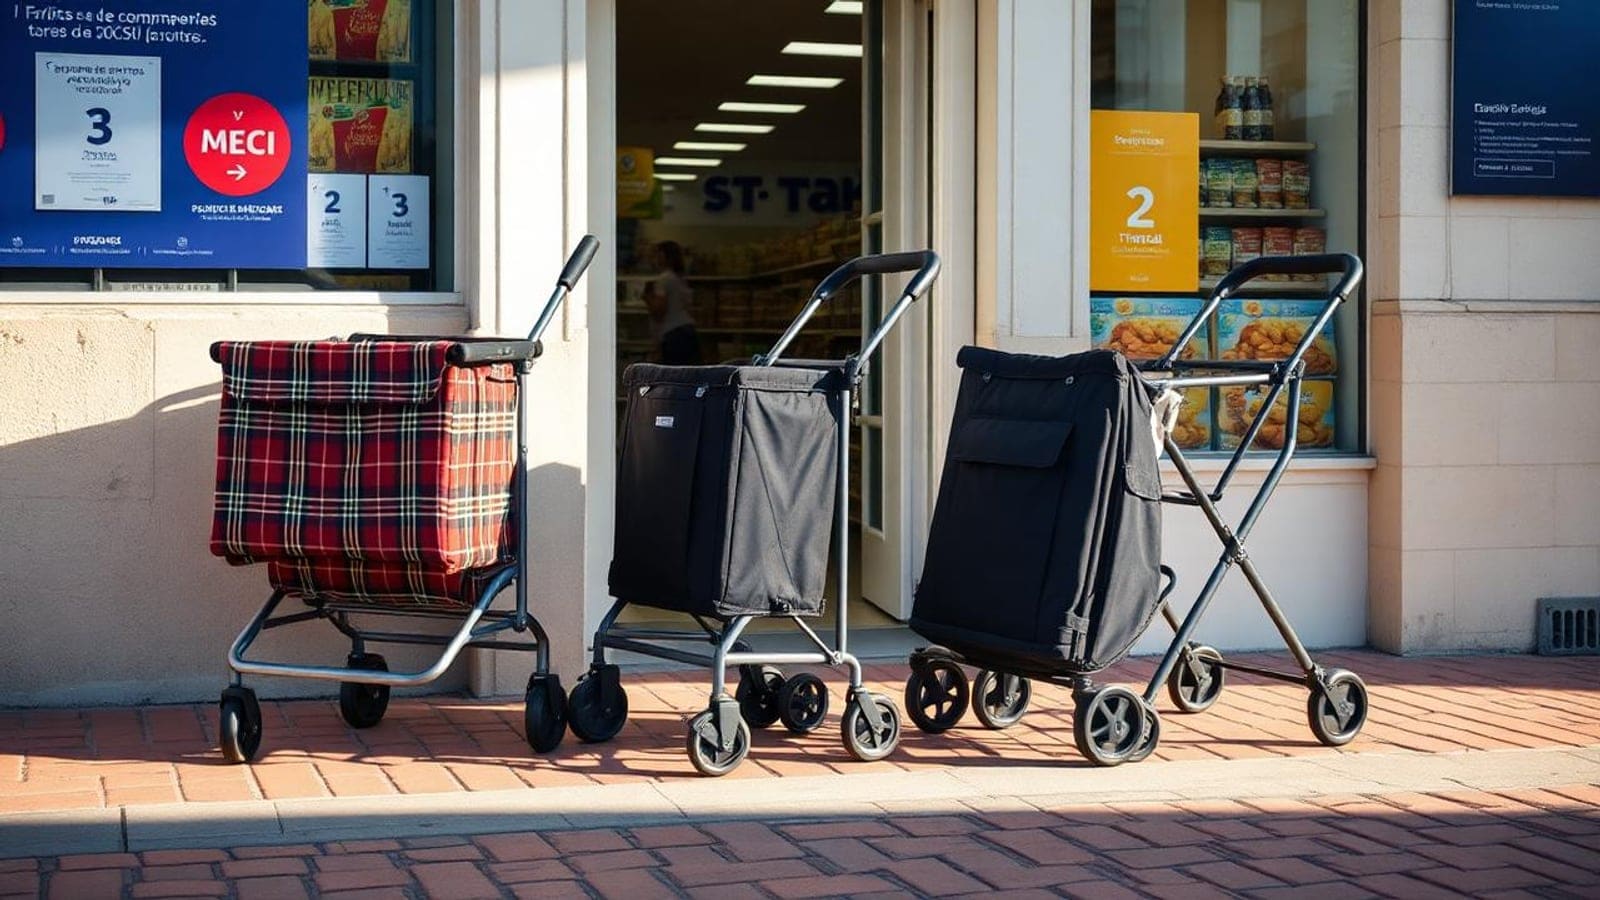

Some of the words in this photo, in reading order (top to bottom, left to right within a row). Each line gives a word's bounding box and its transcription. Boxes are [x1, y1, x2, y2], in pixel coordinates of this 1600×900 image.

[71, 24, 92, 38] de
[86, 107, 112, 145] 3
[201, 128, 275, 155] MECI
[324, 190, 341, 213] 2
[391, 192, 409, 217] 3
[1126, 186, 1155, 228] 2
